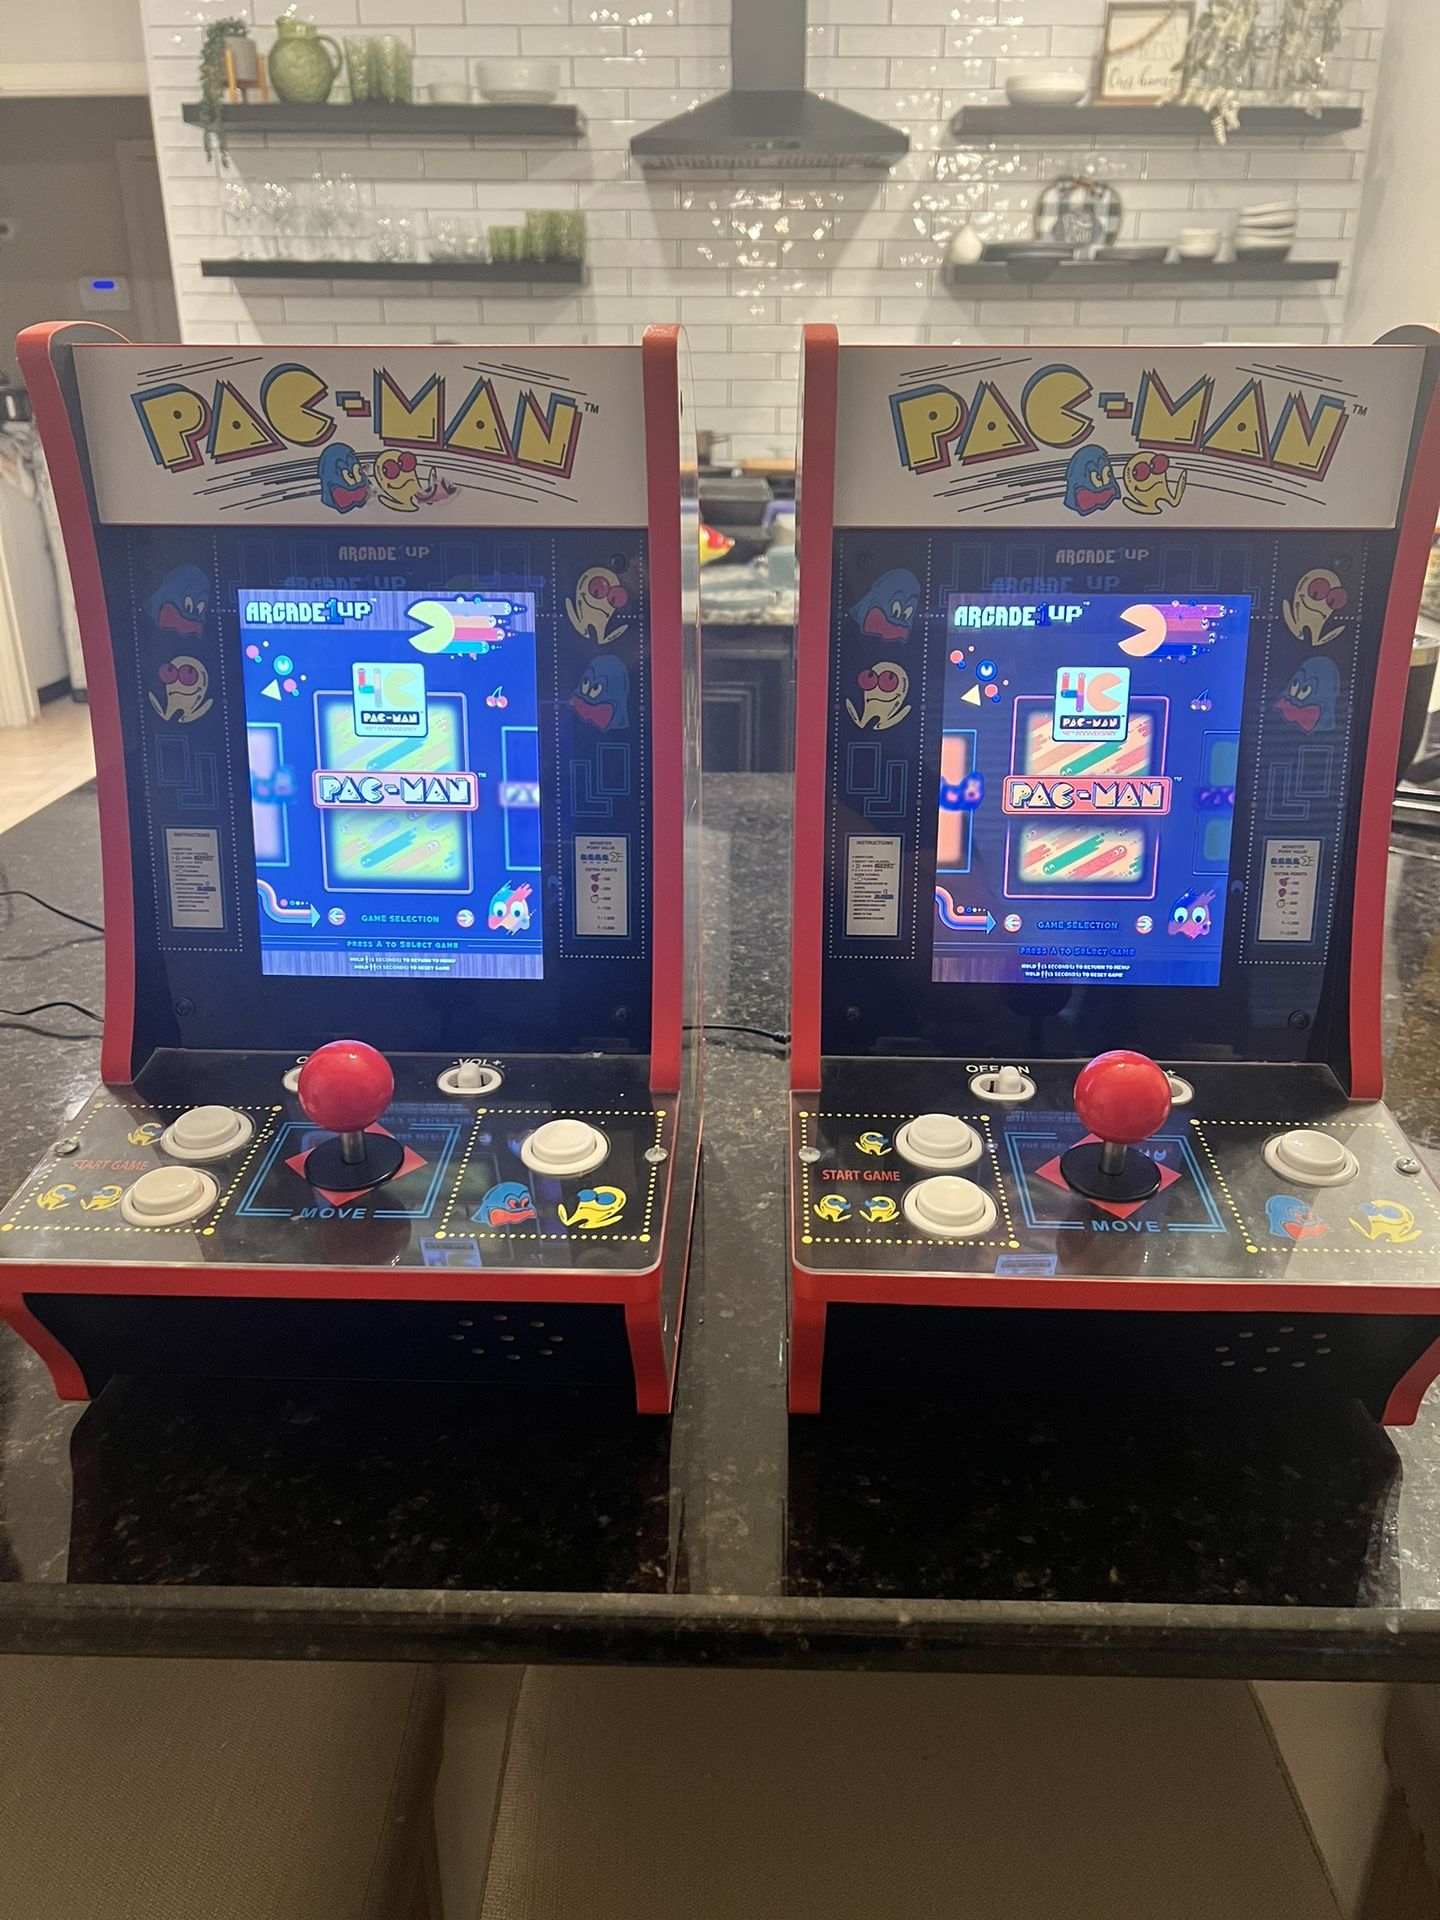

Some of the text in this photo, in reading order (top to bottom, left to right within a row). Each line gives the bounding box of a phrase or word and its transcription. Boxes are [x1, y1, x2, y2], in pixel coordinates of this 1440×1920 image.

[131, 362, 582, 479] PAC-MAN
[889, 363, 1349, 481] PAC-MAN
[362, 712, 418, 723] PAC-MAN
[1062, 717, 1118, 728] PAC-MAN
[319, 775, 471, 804] PAC-MAN
[1010, 781, 1164, 809] PAC-MAN
[361, 914, 440, 923] GAME SELECTION
[1037, 921, 1118, 930] GAME SELECTION
[346, 940, 373, 948] PRESS
[376, 940, 383, 948] A
[400, 941, 433, 949] SELECT
[1020, 946, 1135, 956] PRESS A TO SELECT GAME
[70, 1158, 149, 1172] START GAME
[821, 1169, 901, 1182] START GAME
[300, 1206, 367, 1220] MOVE
[1091, 1219, 1161, 1233] MOVE
